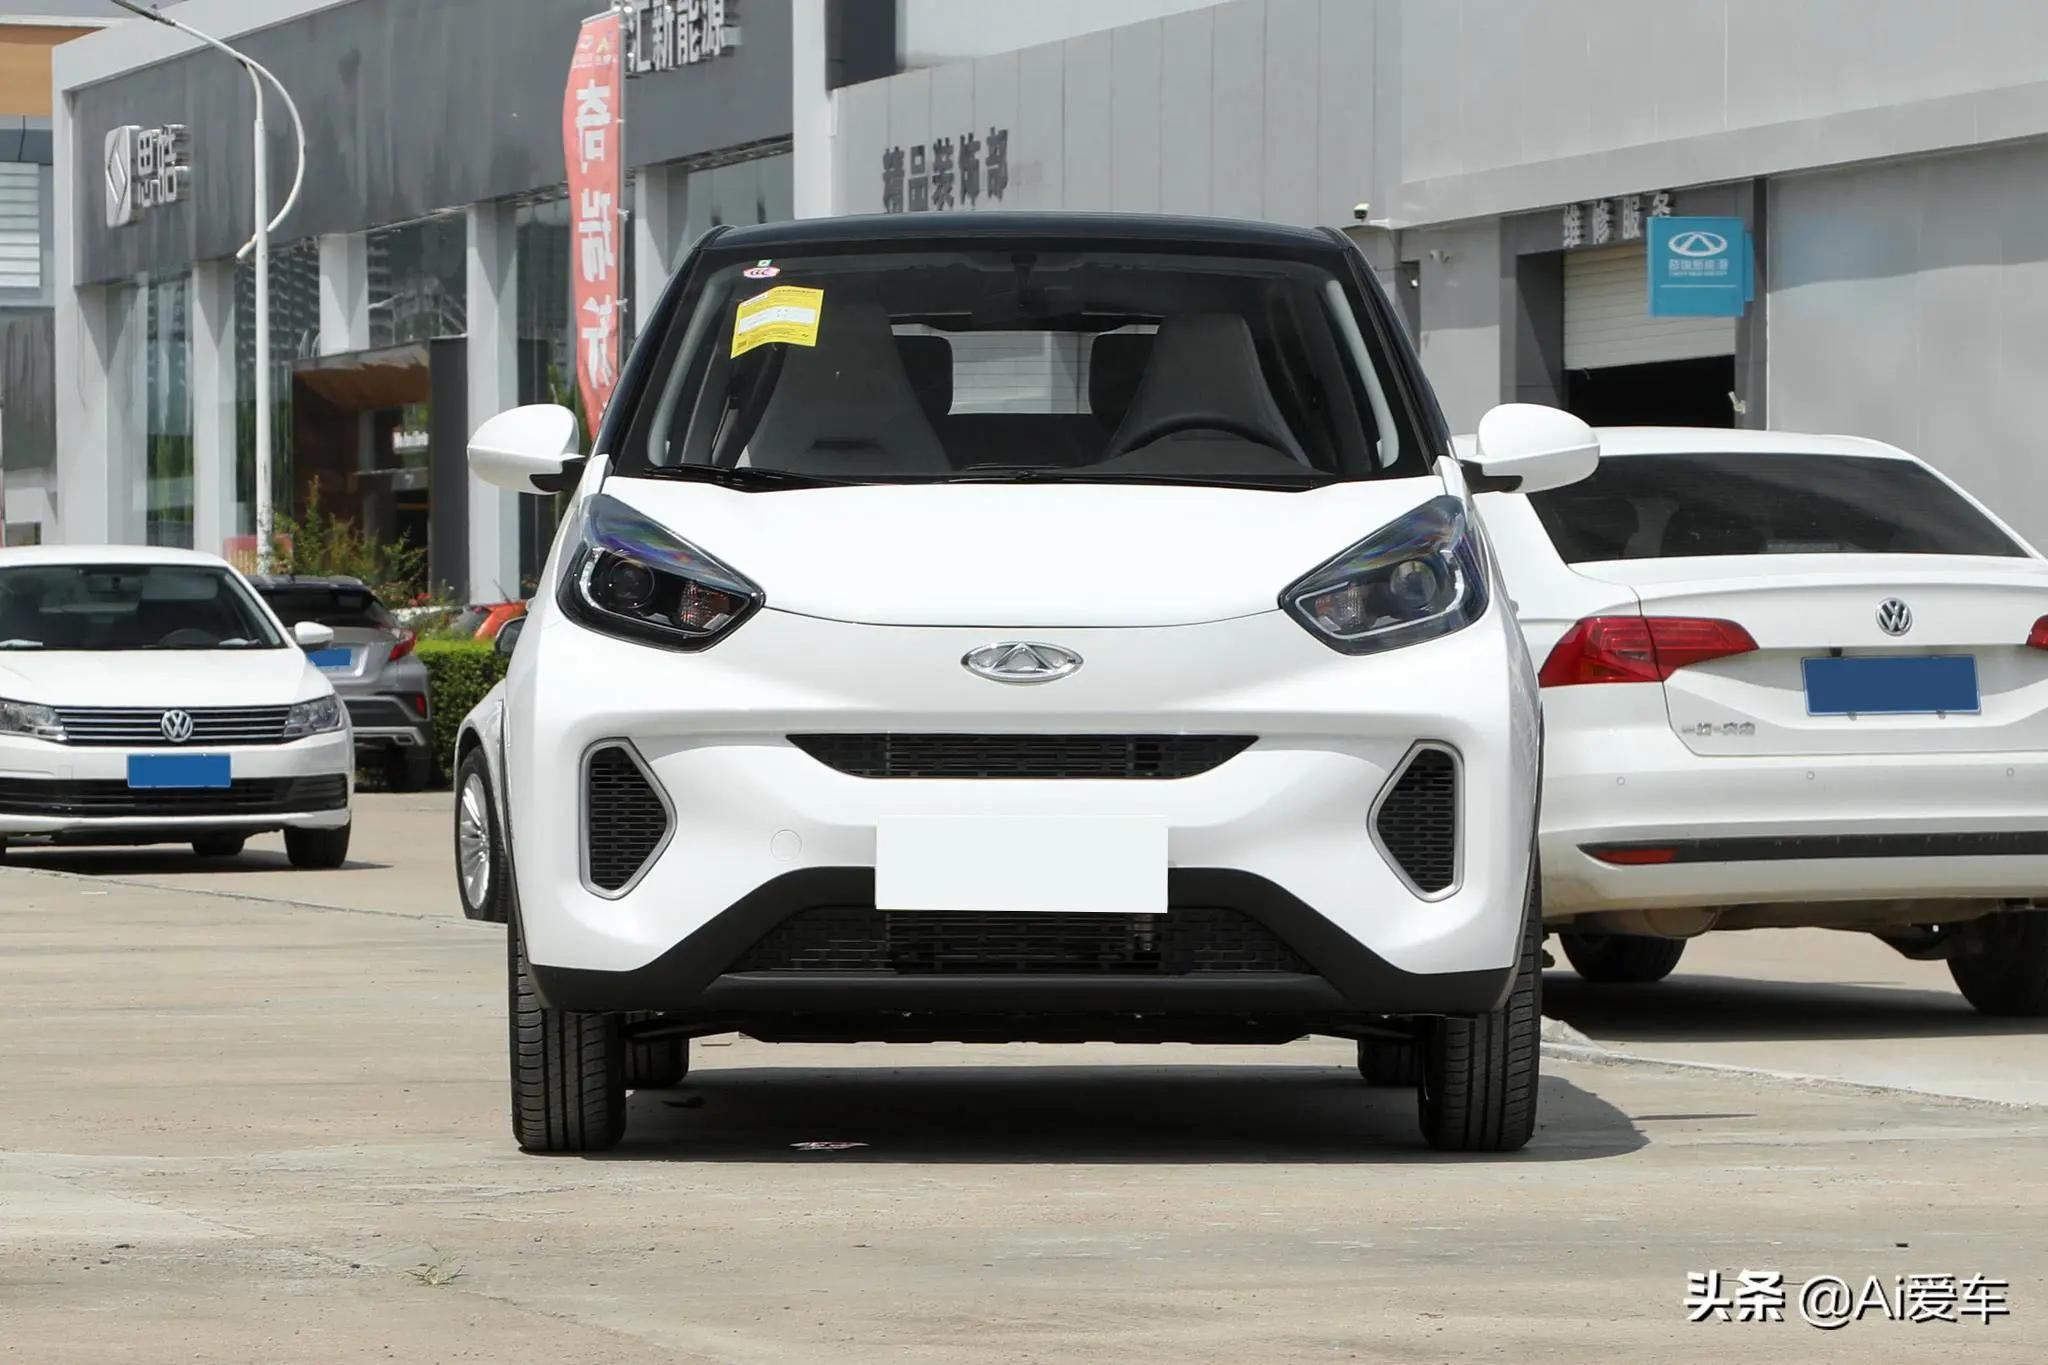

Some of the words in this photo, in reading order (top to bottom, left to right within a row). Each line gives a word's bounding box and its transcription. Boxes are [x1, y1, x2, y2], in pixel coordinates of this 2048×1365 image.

[882, 126, 1008, 213] 精品装饰部
